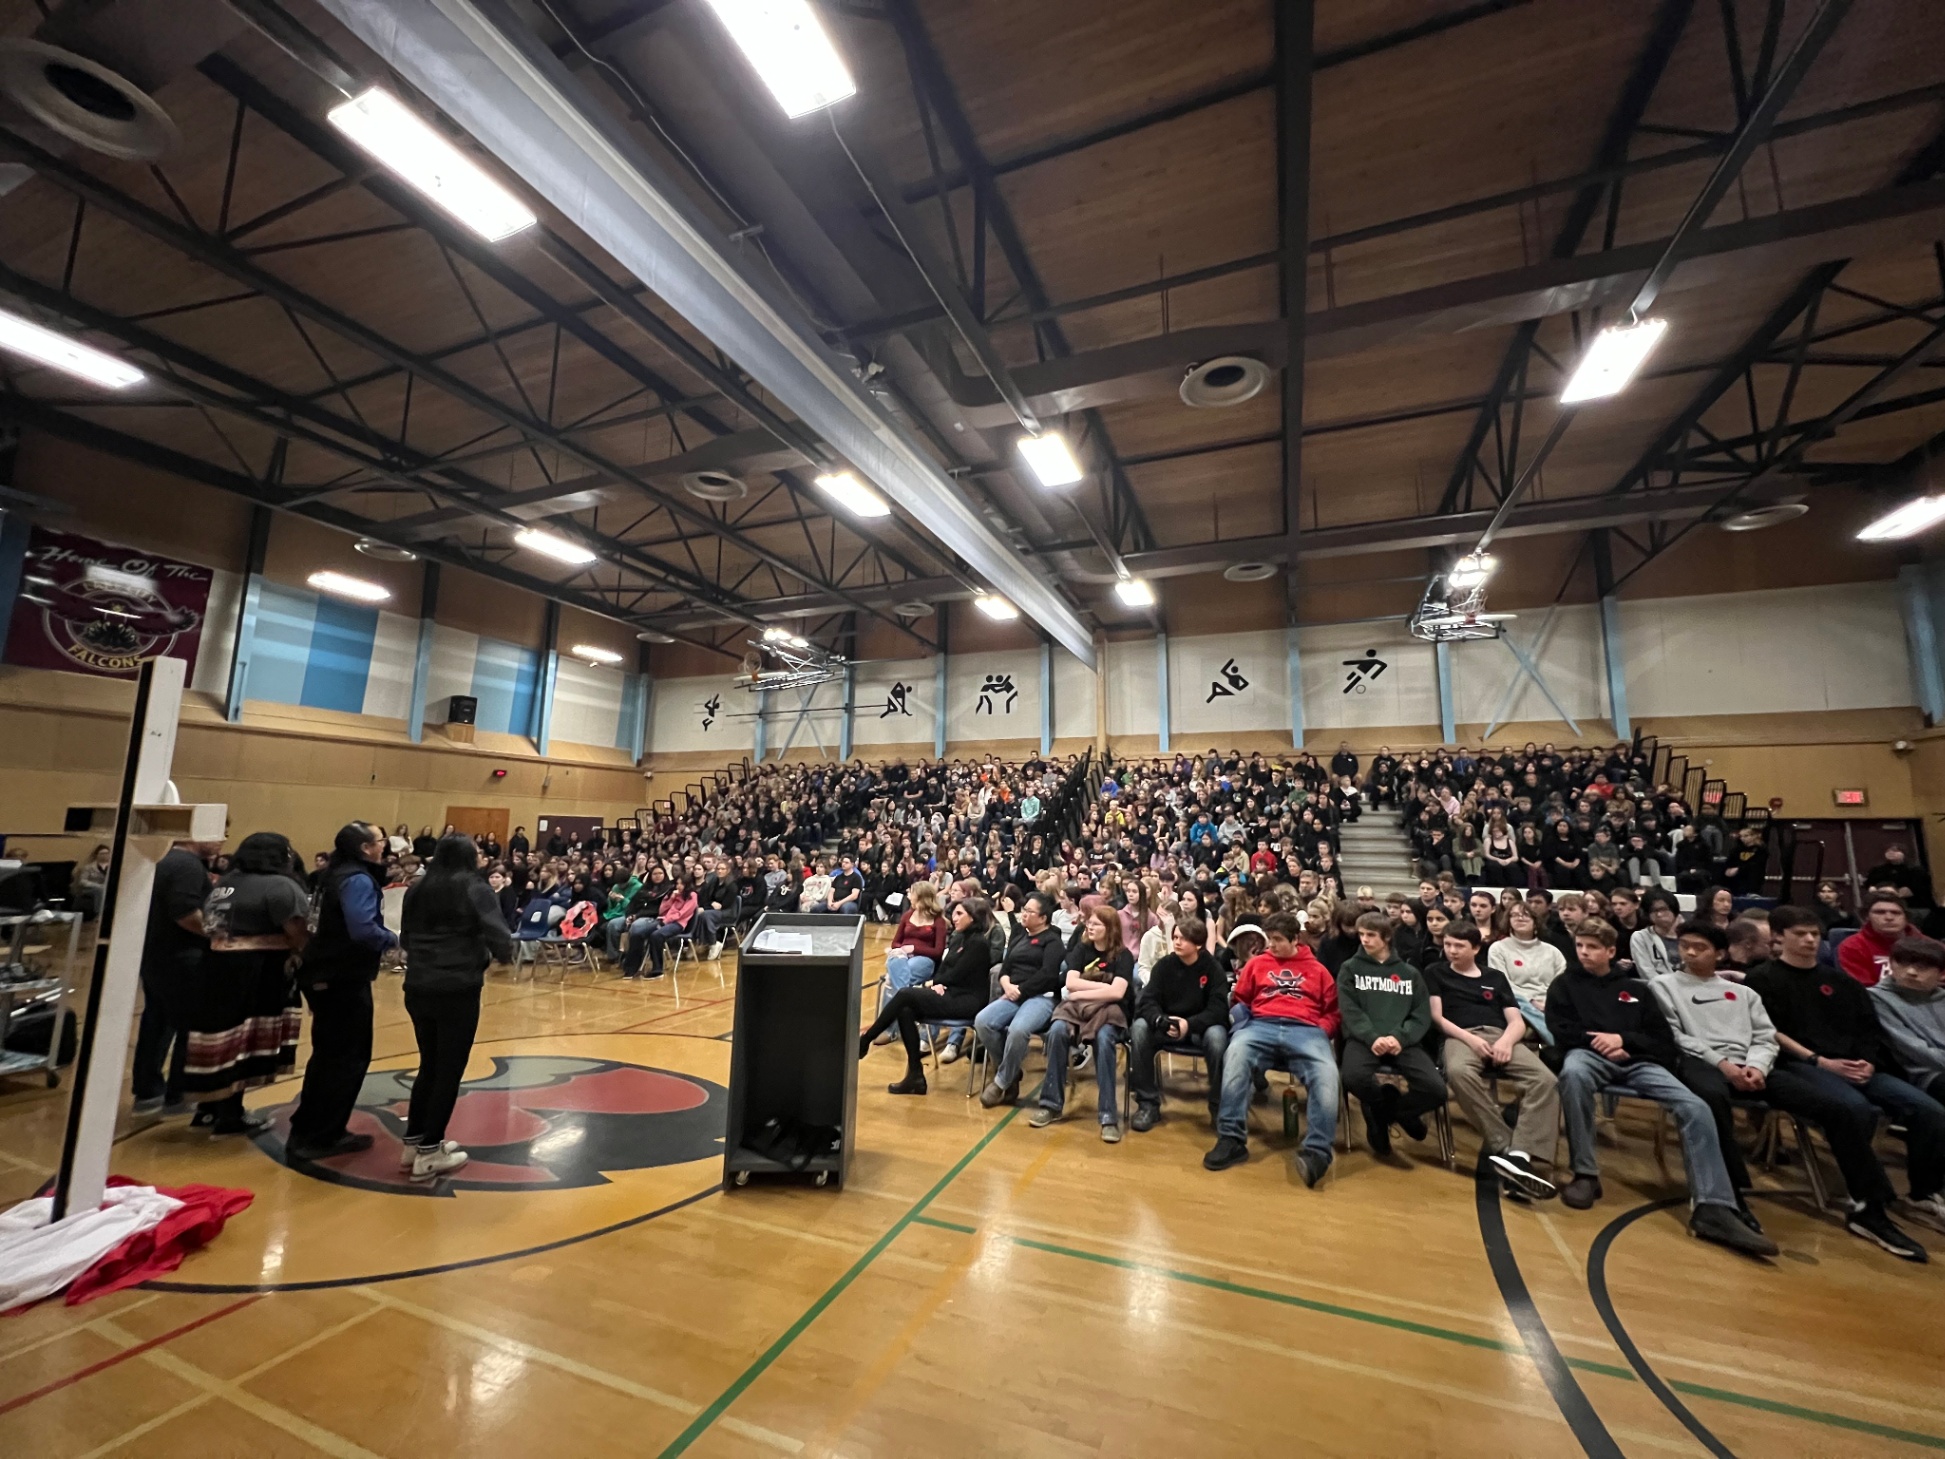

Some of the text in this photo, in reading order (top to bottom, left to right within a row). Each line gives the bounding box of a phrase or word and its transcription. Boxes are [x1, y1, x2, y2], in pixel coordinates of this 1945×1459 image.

[42, 546, 117, 569] Home
[164, 564, 208, 581] The
[1355, 974, 1413, 995] DARTMOUTH
